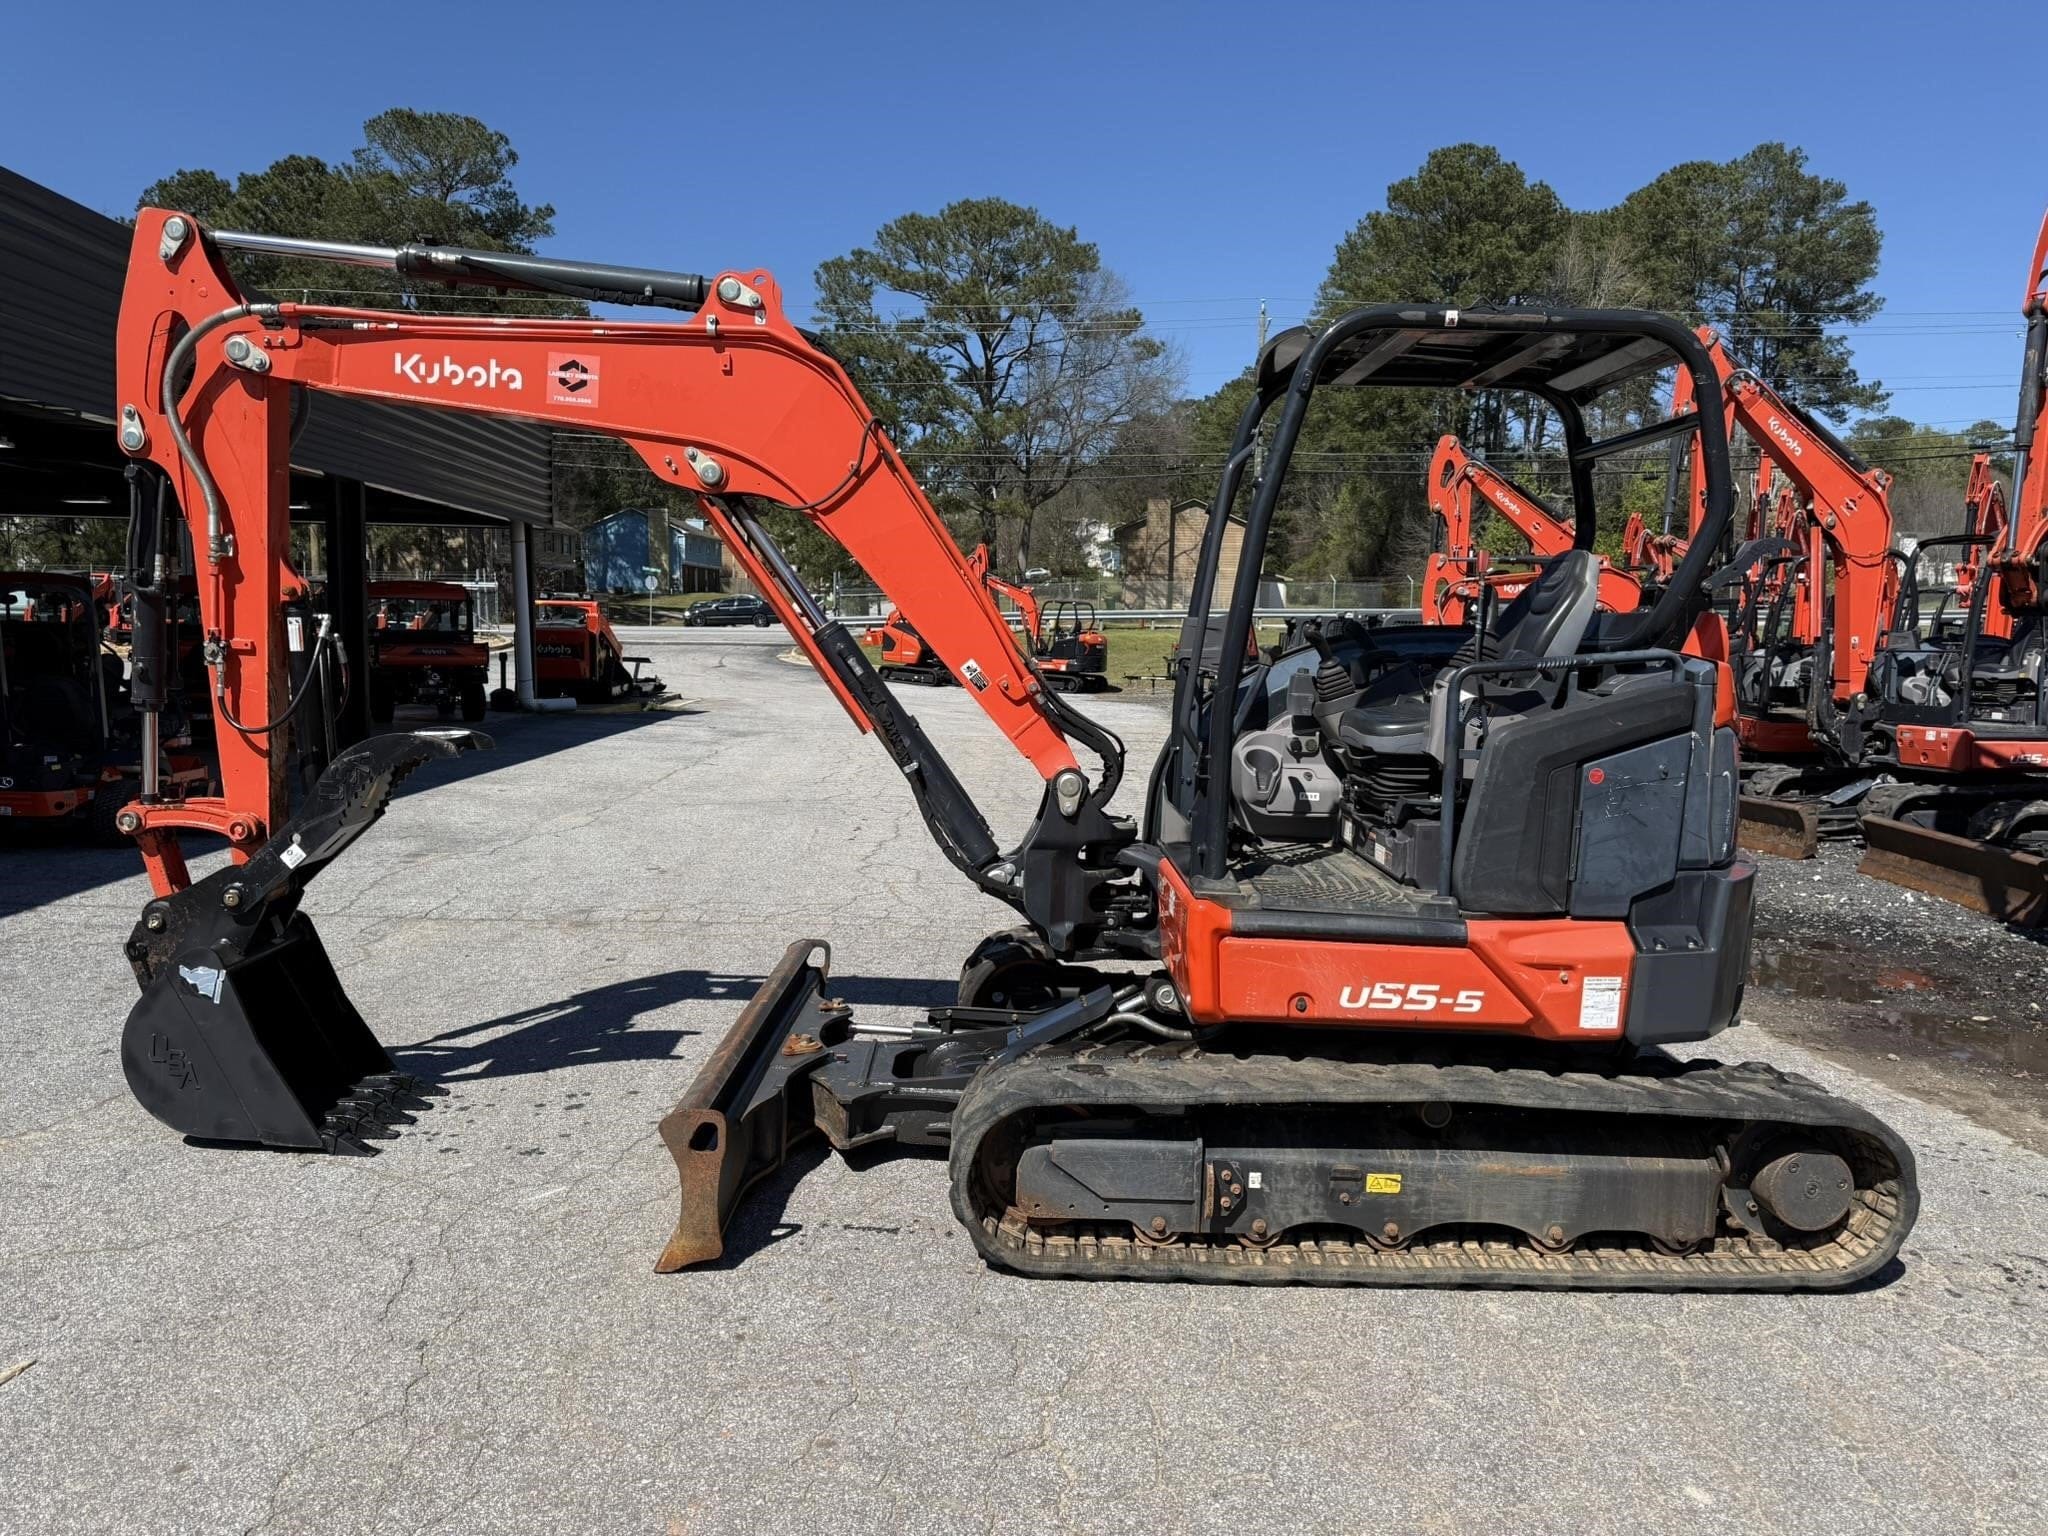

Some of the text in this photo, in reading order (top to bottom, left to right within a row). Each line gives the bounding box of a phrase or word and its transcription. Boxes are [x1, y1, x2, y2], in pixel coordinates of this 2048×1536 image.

[394, 352, 523, 390] Kubota
[1767, 416, 1802, 456] Kubota
[1495, 490, 1520, 515] Kubota
[2010, 753, 2048, 765] U55-
[1339, 983, 1485, 1013] U55-5
